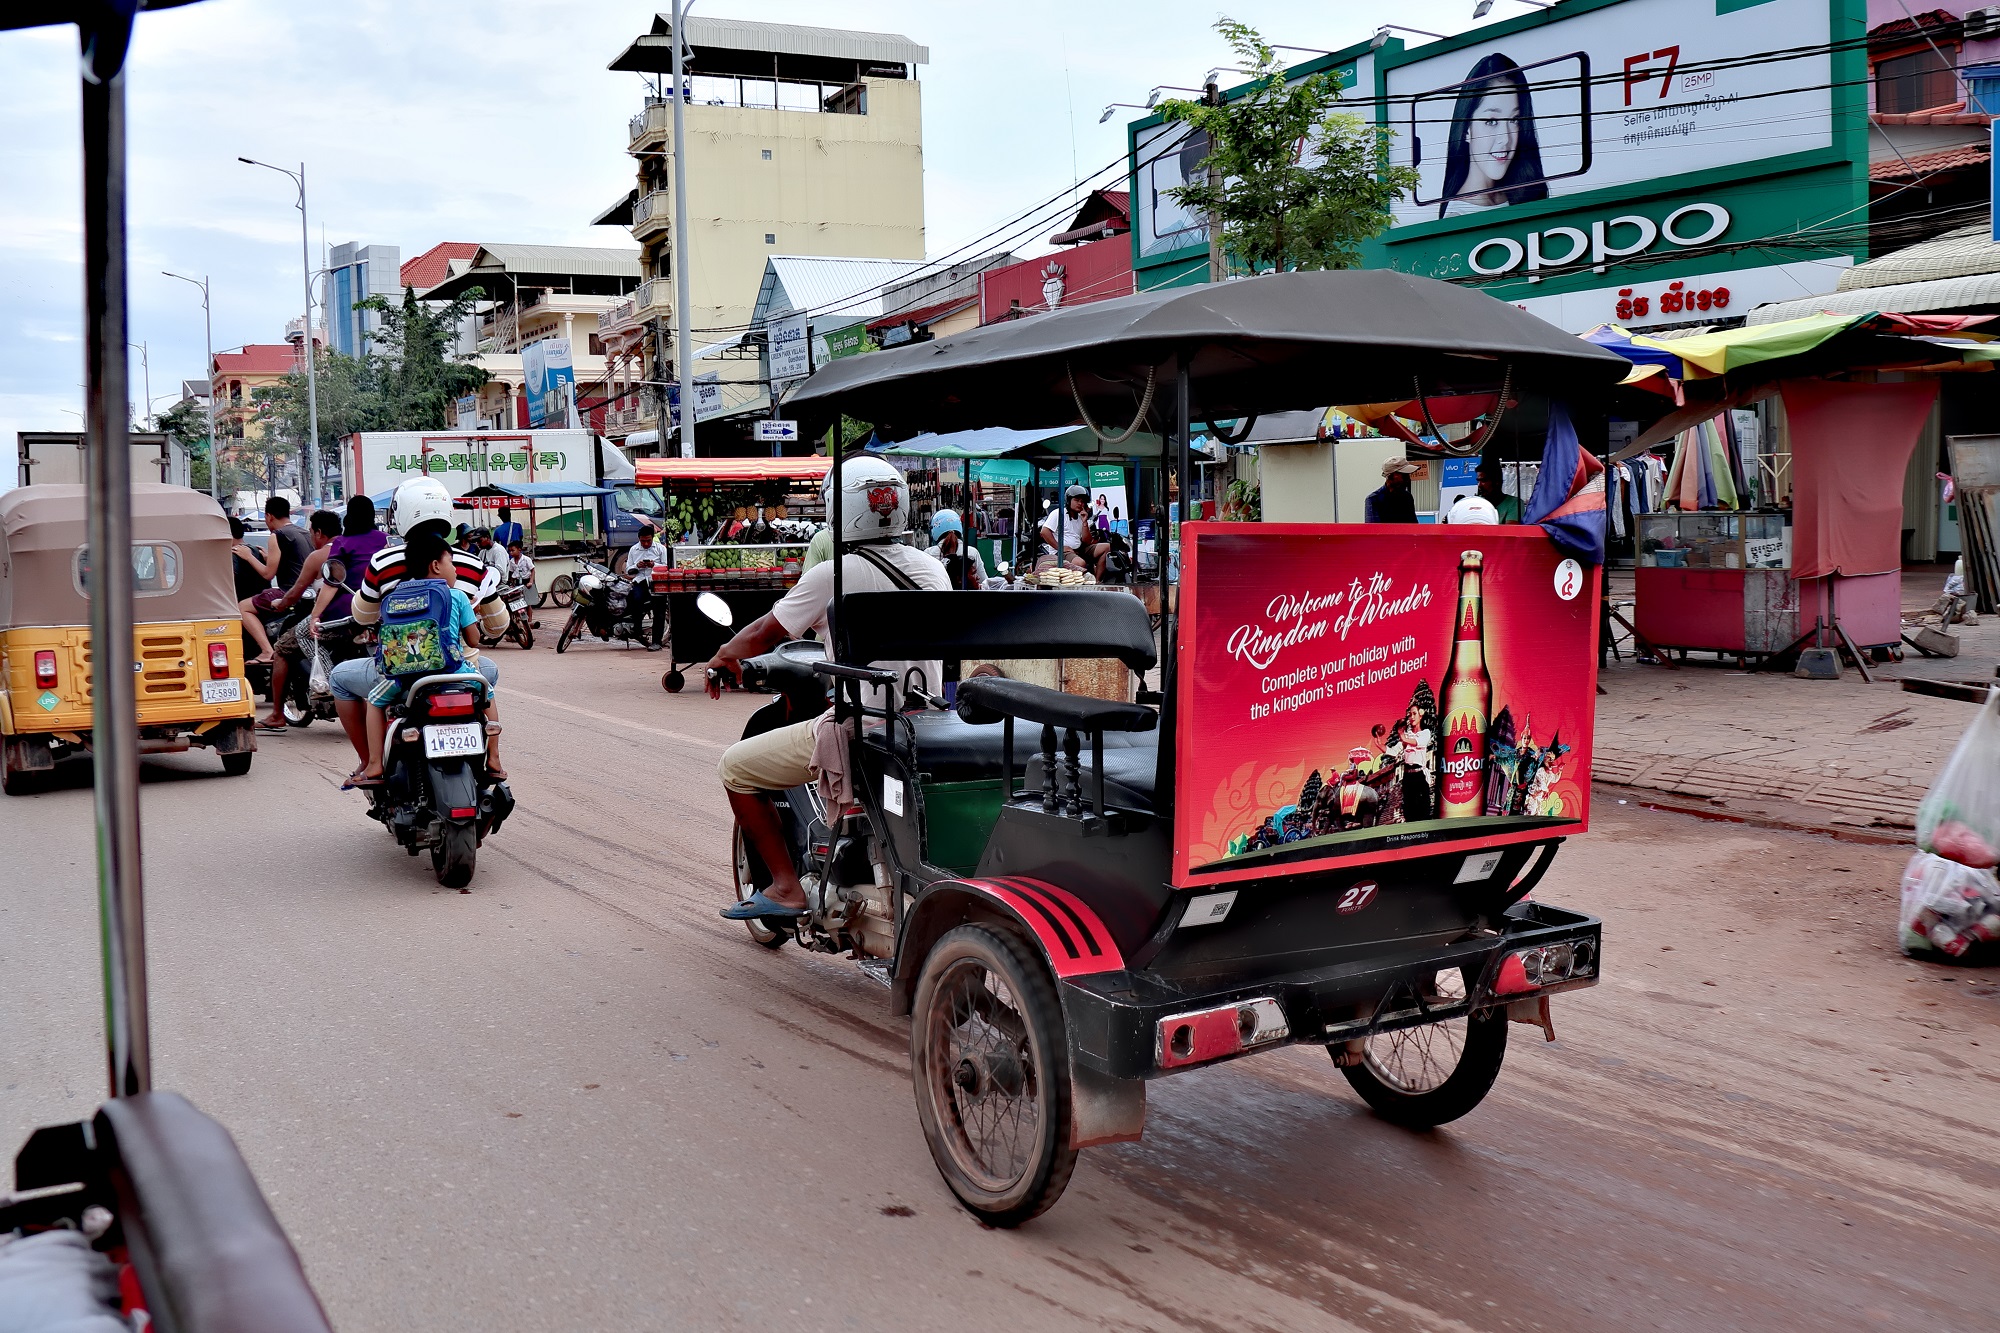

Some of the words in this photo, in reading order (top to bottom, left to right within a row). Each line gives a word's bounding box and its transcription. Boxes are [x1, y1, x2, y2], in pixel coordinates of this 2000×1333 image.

[1624, 45, 1680, 106] F7
[1684, 72, 1712, 88] 25MP
[1623, 112, 1651, 127] Selfie
[1266, 591, 1344, 623] Welcome
[1348, 577, 1365, 602] to
[1369, 571, 1393, 595] the
[1226, 614, 1330, 670] Kingdom
[1334, 604, 1359, 641] of
[1350, 583, 1433, 627] Wonder
[1261, 662, 1318, 694] Complete
[1320, 657, 1347, 681] your
[1349, 643, 1389, 669] holiday
[1392, 635, 1416, 655] with
[206, 687, 238, 700] 1Z-5890
[1250, 703, 1270, 720] the
[1336, 675, 1365, 695] most
[1367, 663, 1397, 685] loved
[1400, 652, 1428, 675] beer!
[41, 697, 55, 705] LPG
[1440, 756, 1485, 779] Angkor
[1400, 832, 1429, 841] Responsibly
[1338, 884, 1377, 908] 27
